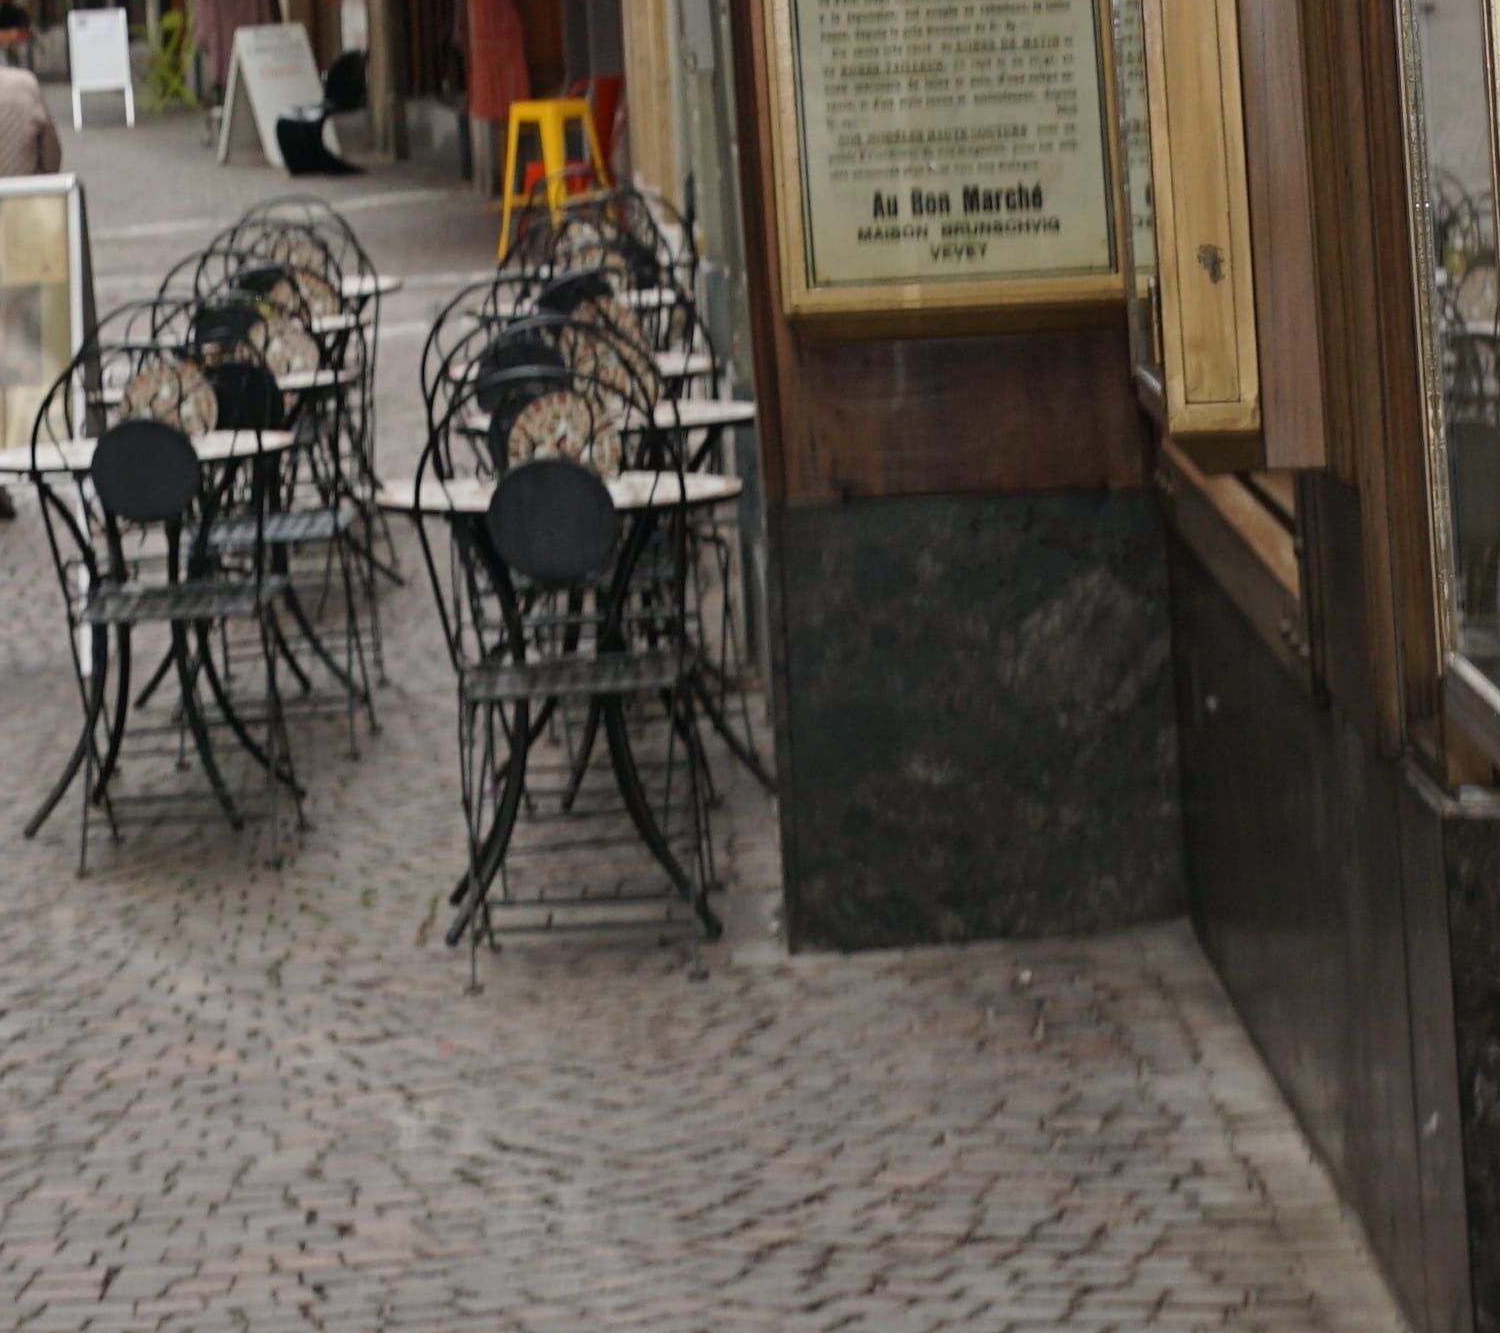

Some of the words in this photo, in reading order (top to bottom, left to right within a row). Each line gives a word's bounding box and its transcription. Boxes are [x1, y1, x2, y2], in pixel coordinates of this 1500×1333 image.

[873, 187, 898, 219] Au
[911, 185, 950, 217] Bon
[962, 180, 1043, 214] Marché
[931, 242, 987, 262] VEVEY
